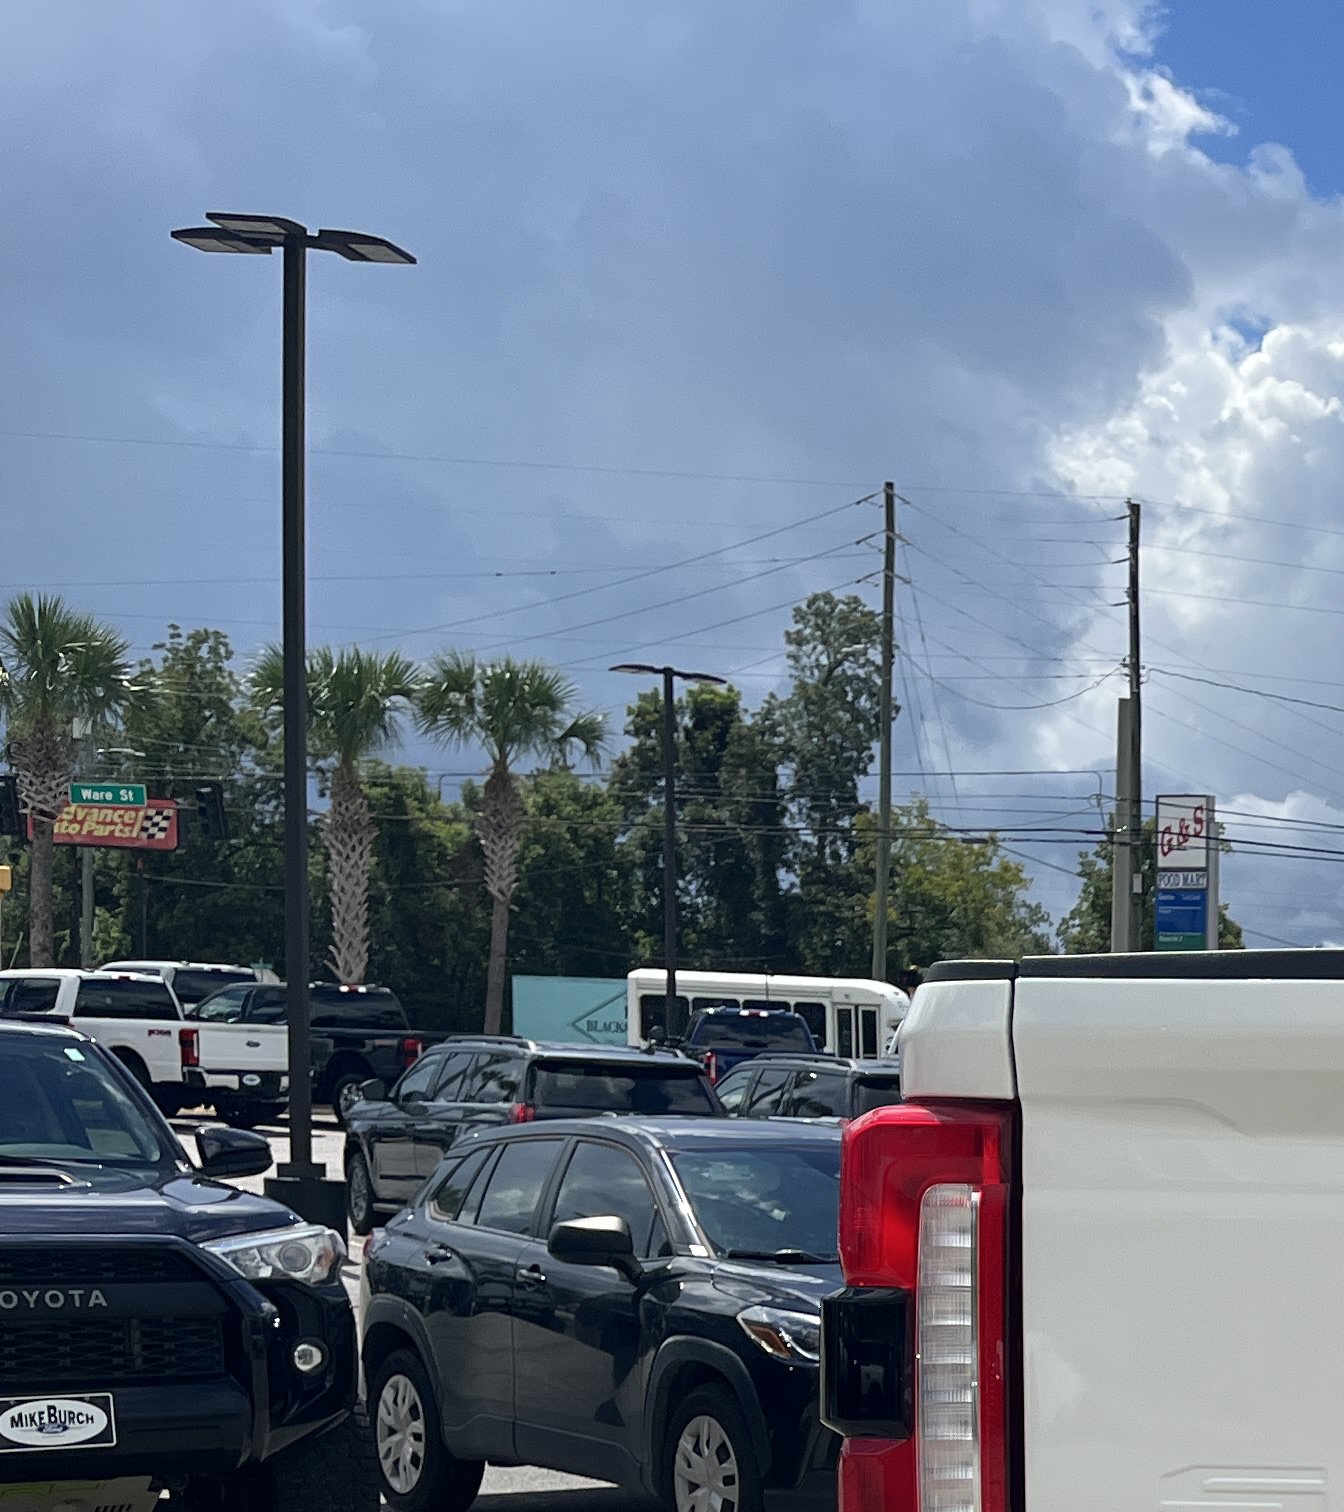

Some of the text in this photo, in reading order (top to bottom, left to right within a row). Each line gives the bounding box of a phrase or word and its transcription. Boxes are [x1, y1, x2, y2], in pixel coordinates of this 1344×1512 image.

[80, 788, 135, 802] Ware St
[62, 803, 136, 824] dvance
[82, 821, 133, 838] Parts
[1182, 872, 1207, 889] MART
[0, 1289, 108, 1309] OYOTA
